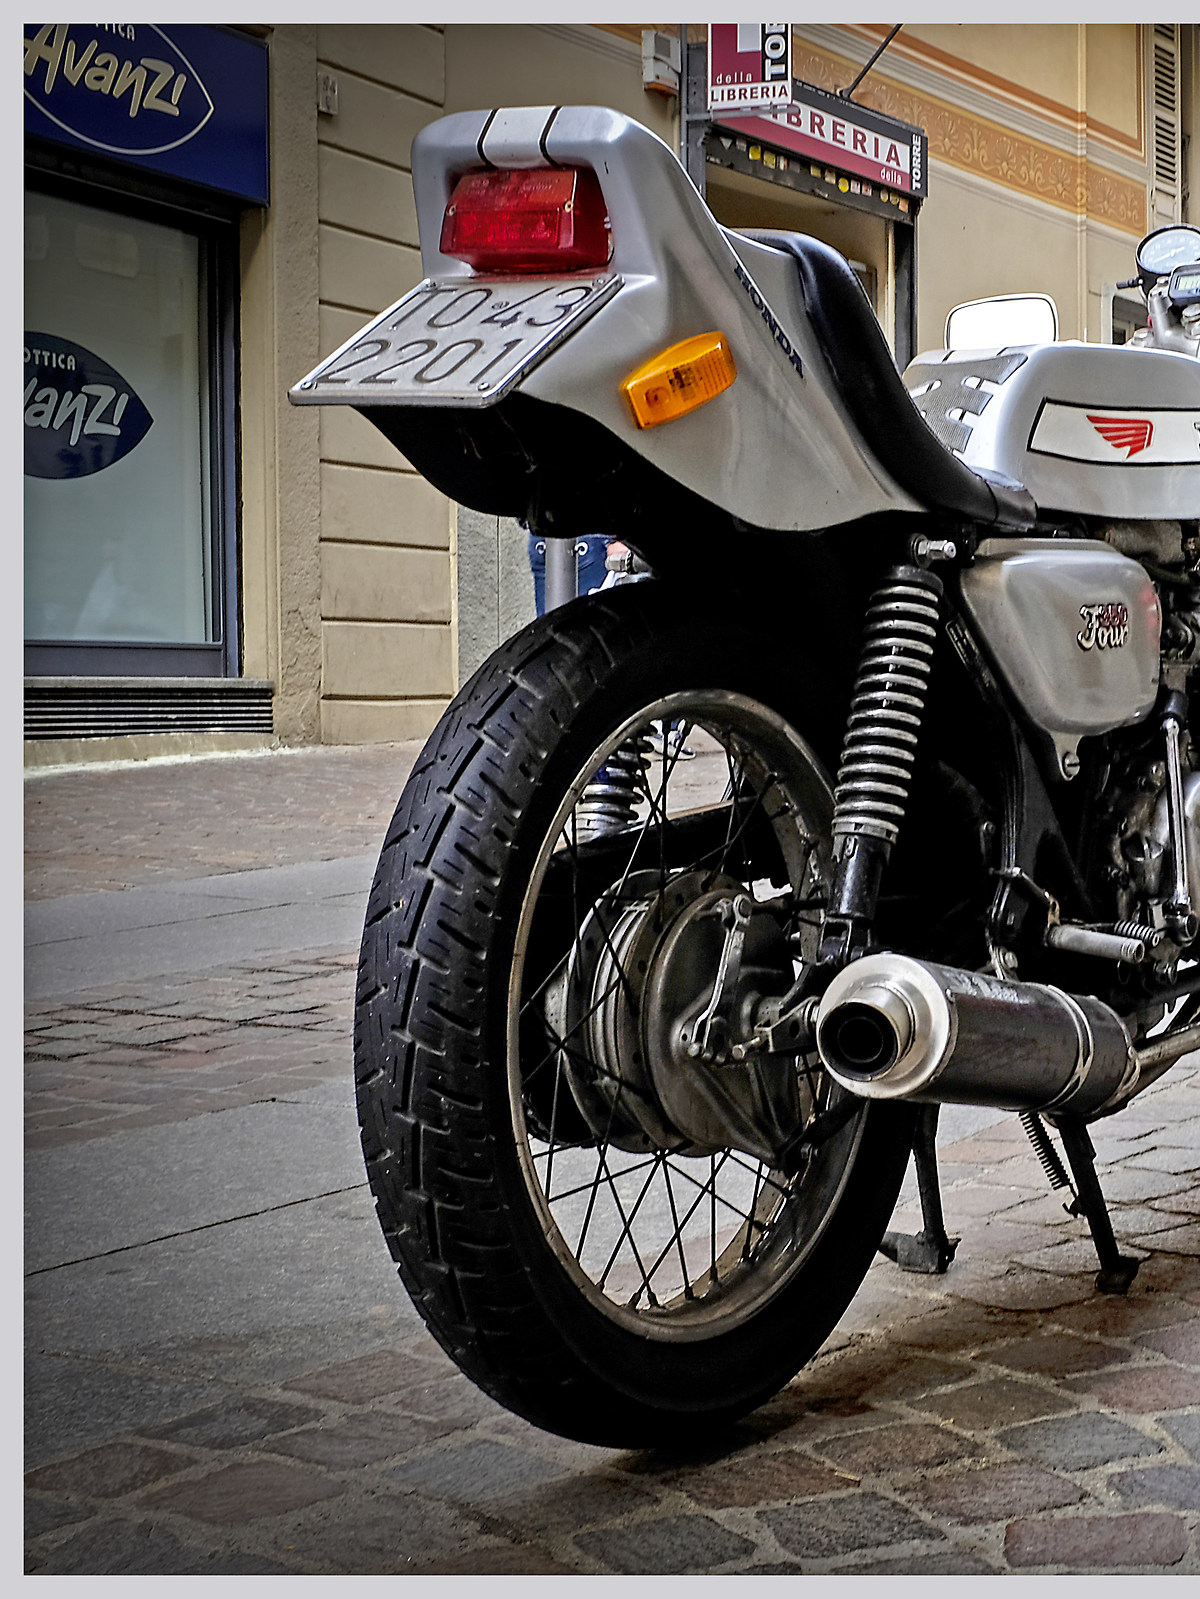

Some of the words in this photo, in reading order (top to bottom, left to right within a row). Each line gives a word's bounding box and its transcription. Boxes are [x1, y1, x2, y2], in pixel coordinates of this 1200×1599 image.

[711, 84, 789, 102] LIBRERIA
[716, 72, 752, 84] della
[880, 167, 902, 186] della
[911, 134, 923, 191] TORRE
[391, 286, 493, 329] TO
[480, 285, 594, 328] 43
[734, 263, 804, 379] HONDA
[313, 338, 524, 385] 2201
